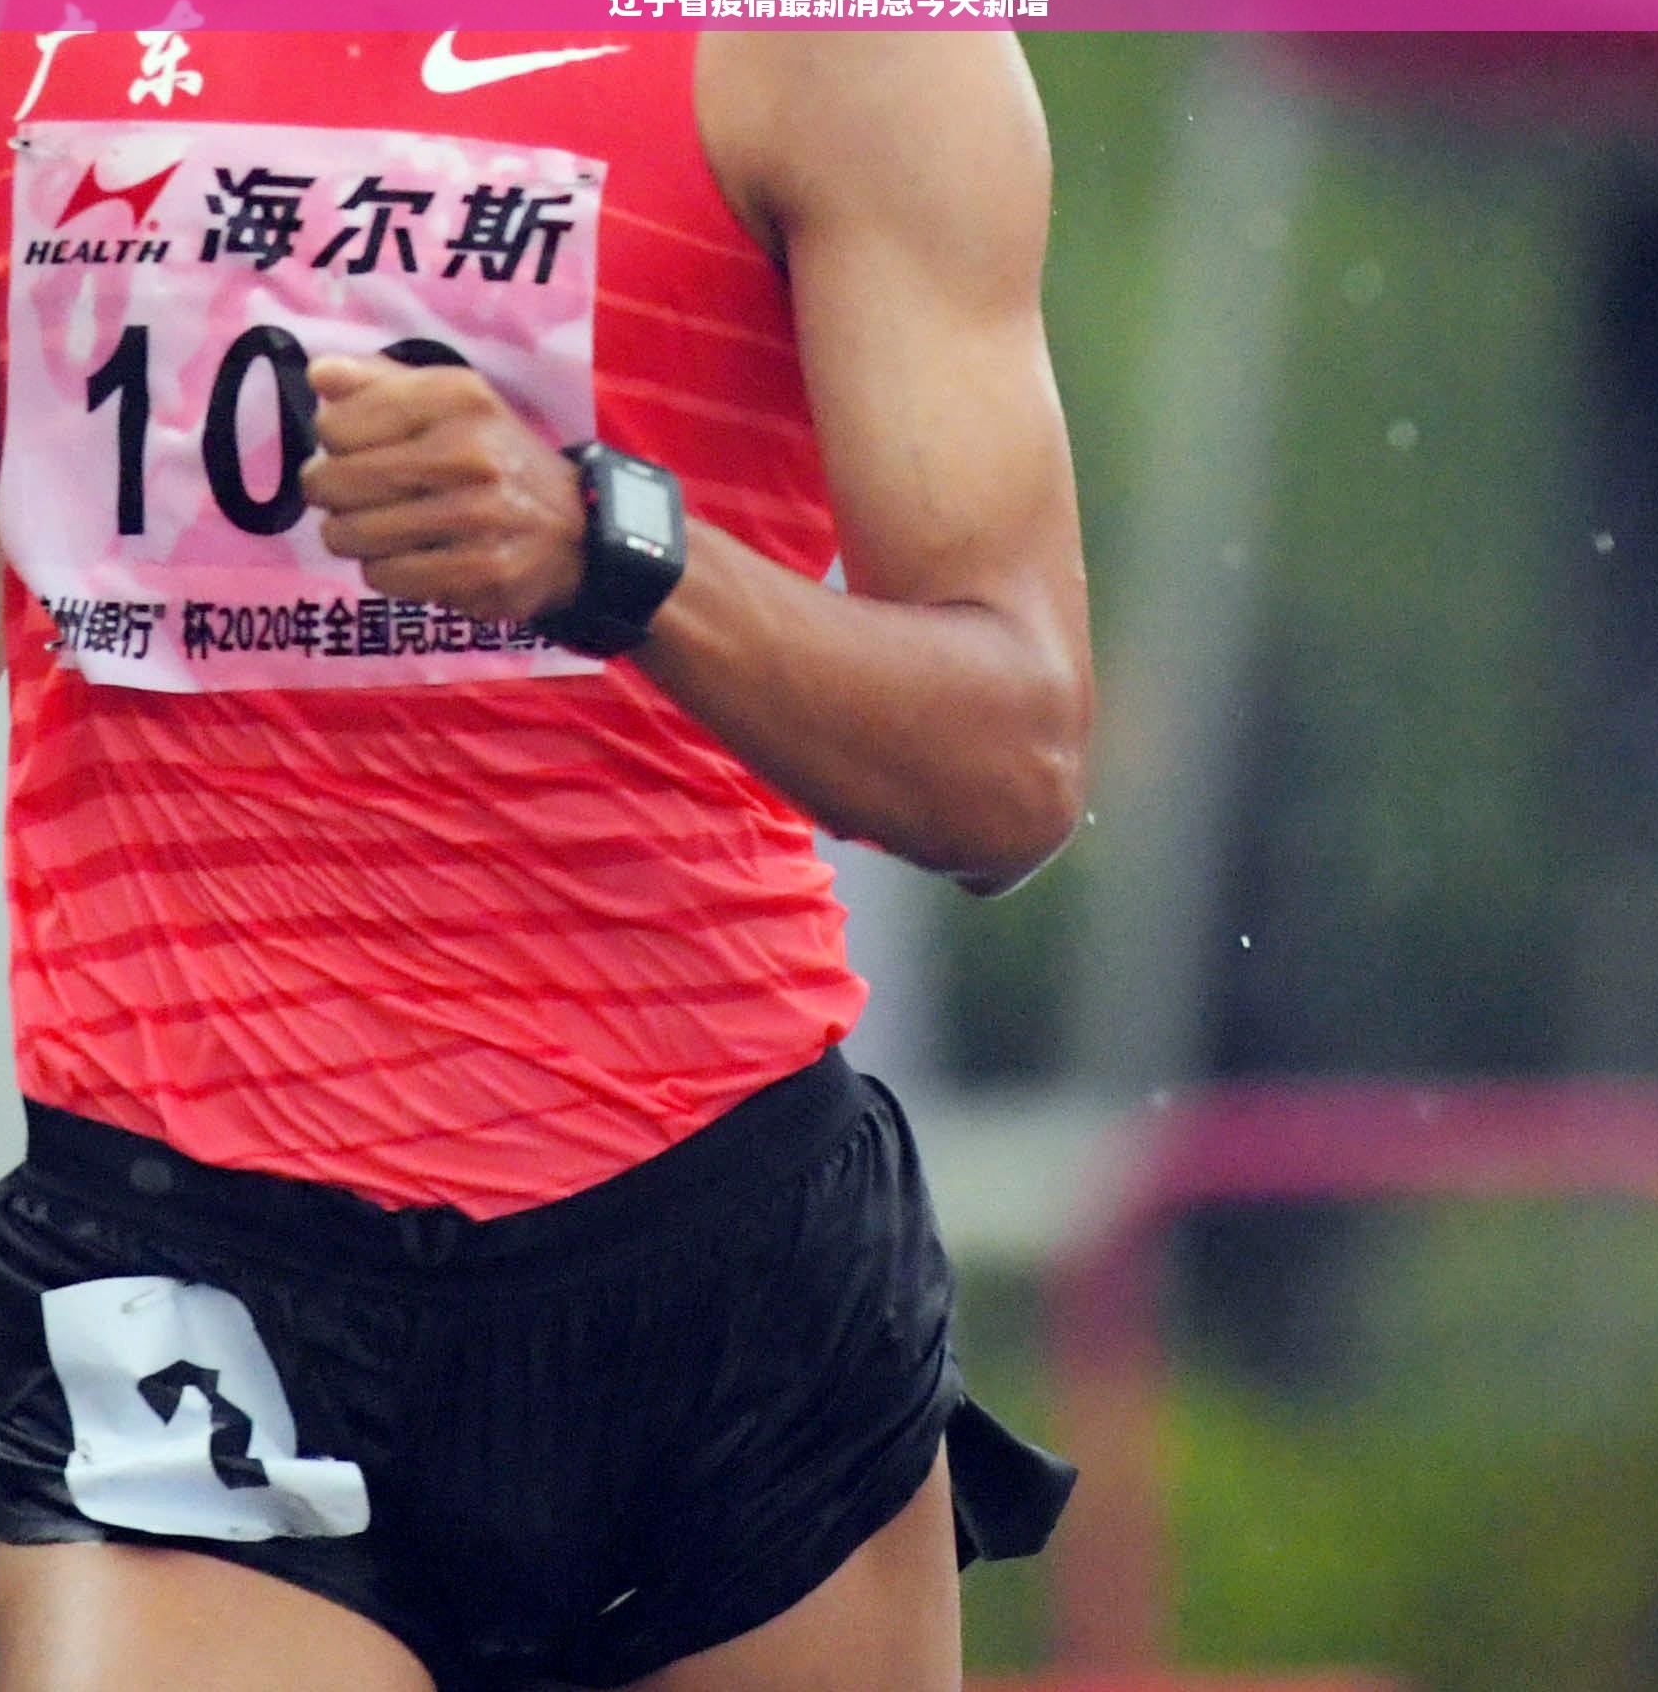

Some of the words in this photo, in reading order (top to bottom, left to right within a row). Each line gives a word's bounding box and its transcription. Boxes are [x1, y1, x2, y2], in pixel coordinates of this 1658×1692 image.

[24, 239, 171, 265] HEALTH
[199, 166, 573, 285] 海尔斯
[86, 324, 472, 536] 10
